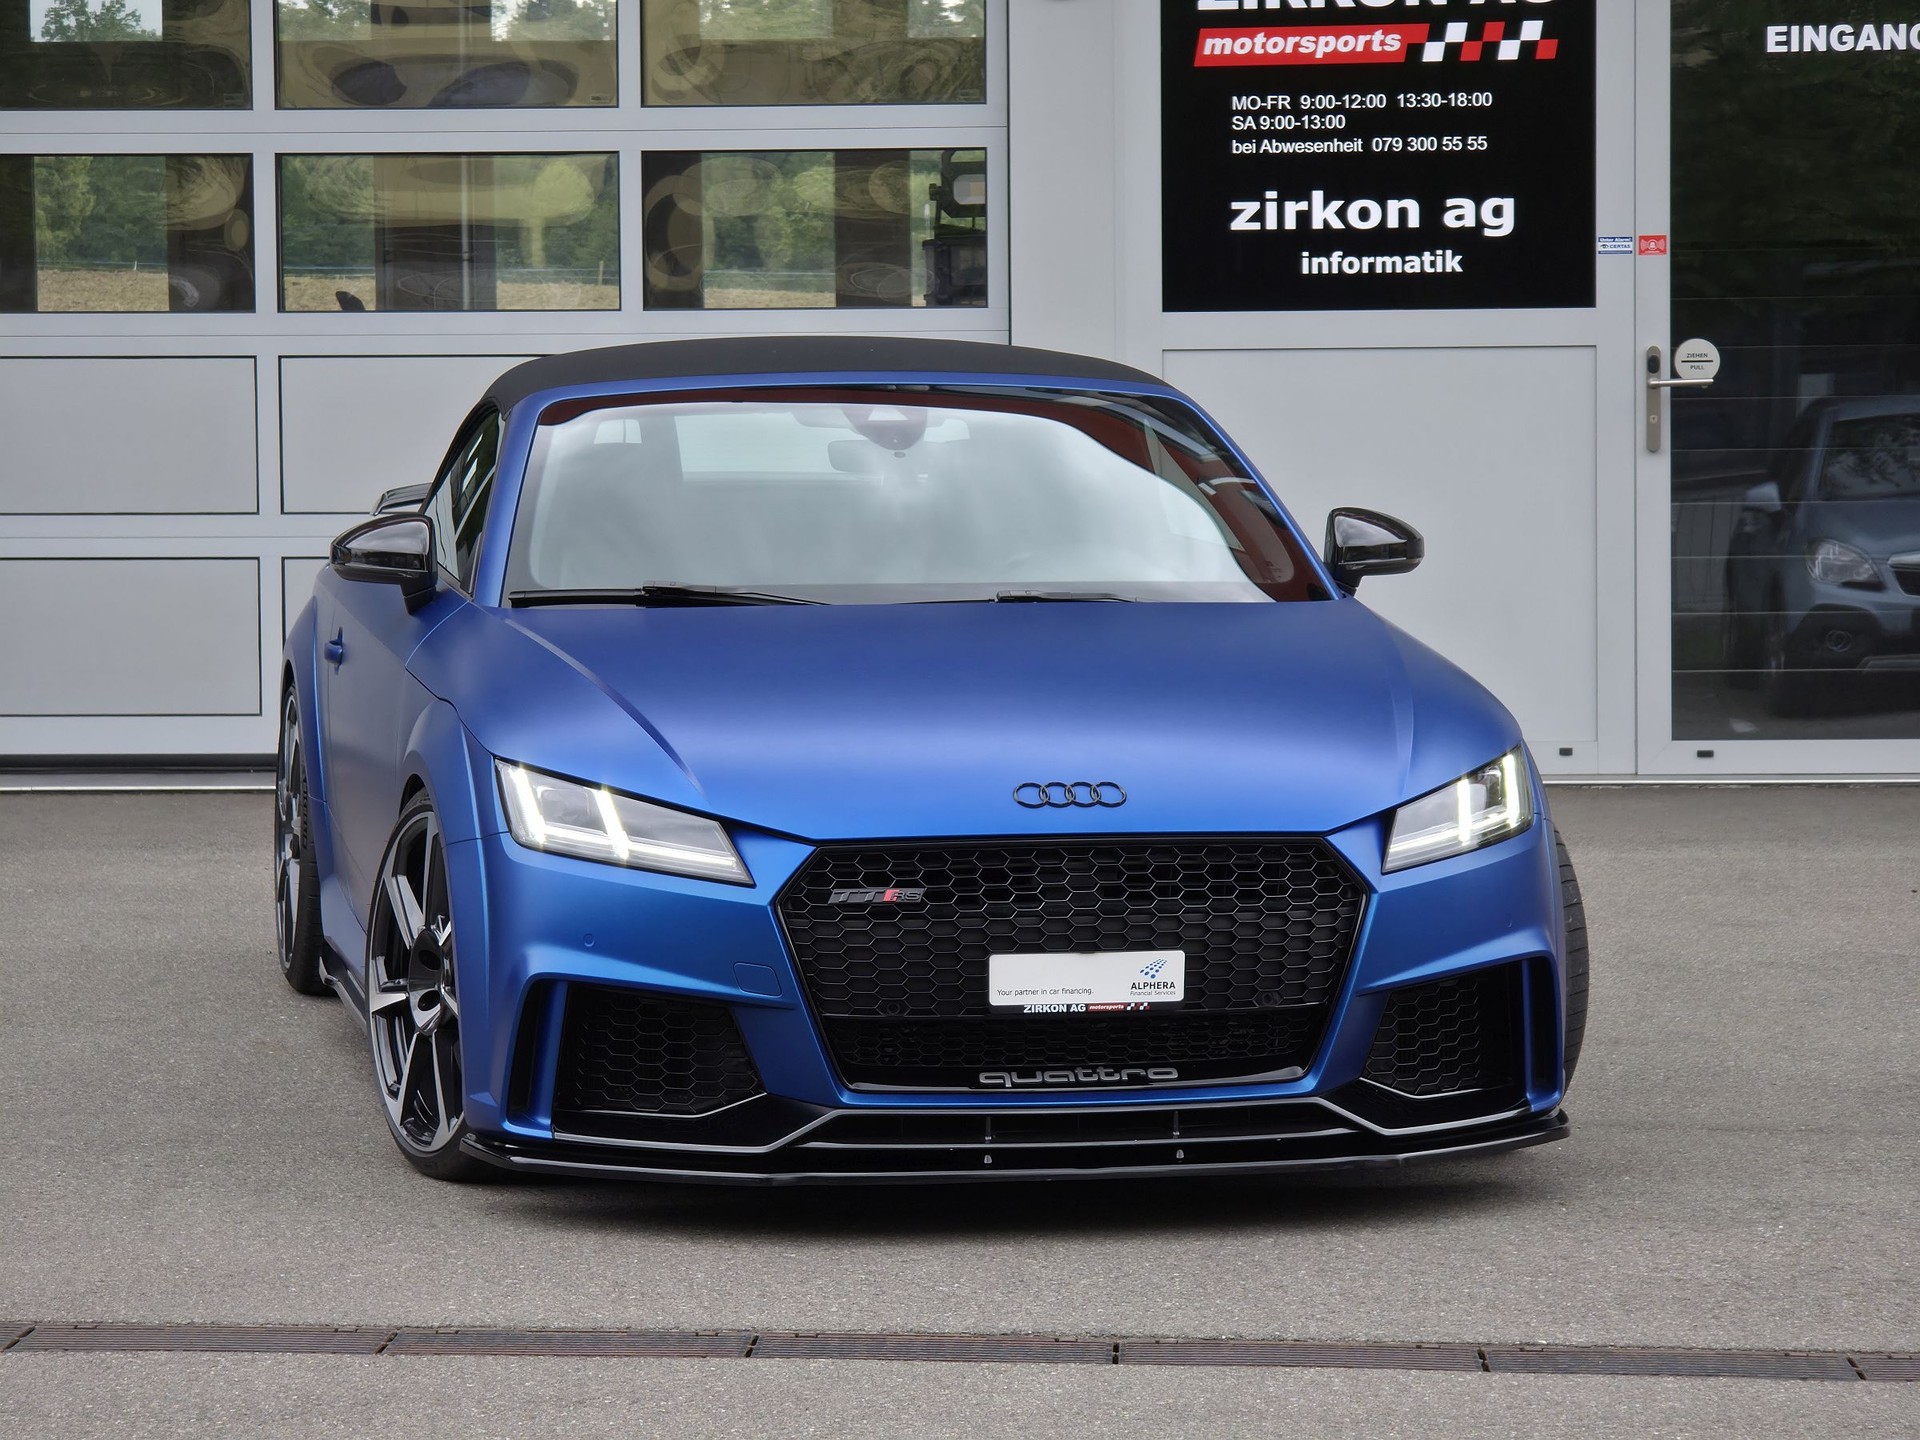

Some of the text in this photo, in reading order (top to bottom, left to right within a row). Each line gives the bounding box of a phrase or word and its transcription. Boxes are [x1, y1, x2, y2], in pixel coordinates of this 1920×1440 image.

[1202, 29, 1402, 59] motorsports
[1231, 92, 1493, 111] MO-FR 9:00-12:00 13:30-18:00
[1231, 114, 1346, 131] SA 9:00-13:00
[1231, 135, 1488, 155] bei Abwesenheit 079 300 55 55
[1230, 190, 1515, 237] zirkon ag
[1301, 250, 1463, 275] informatik
[1014, 988, 1039, 997] partner
[1061, 987, 1095, 996] financing.
[1130, 981, 1176, 990] ALPHERA
[1023, 1004, 1067, 1013] ZIRKON
[1069, 1004, 1086, 1012] AG
[978, 1067, 1179, 1088] quattro
